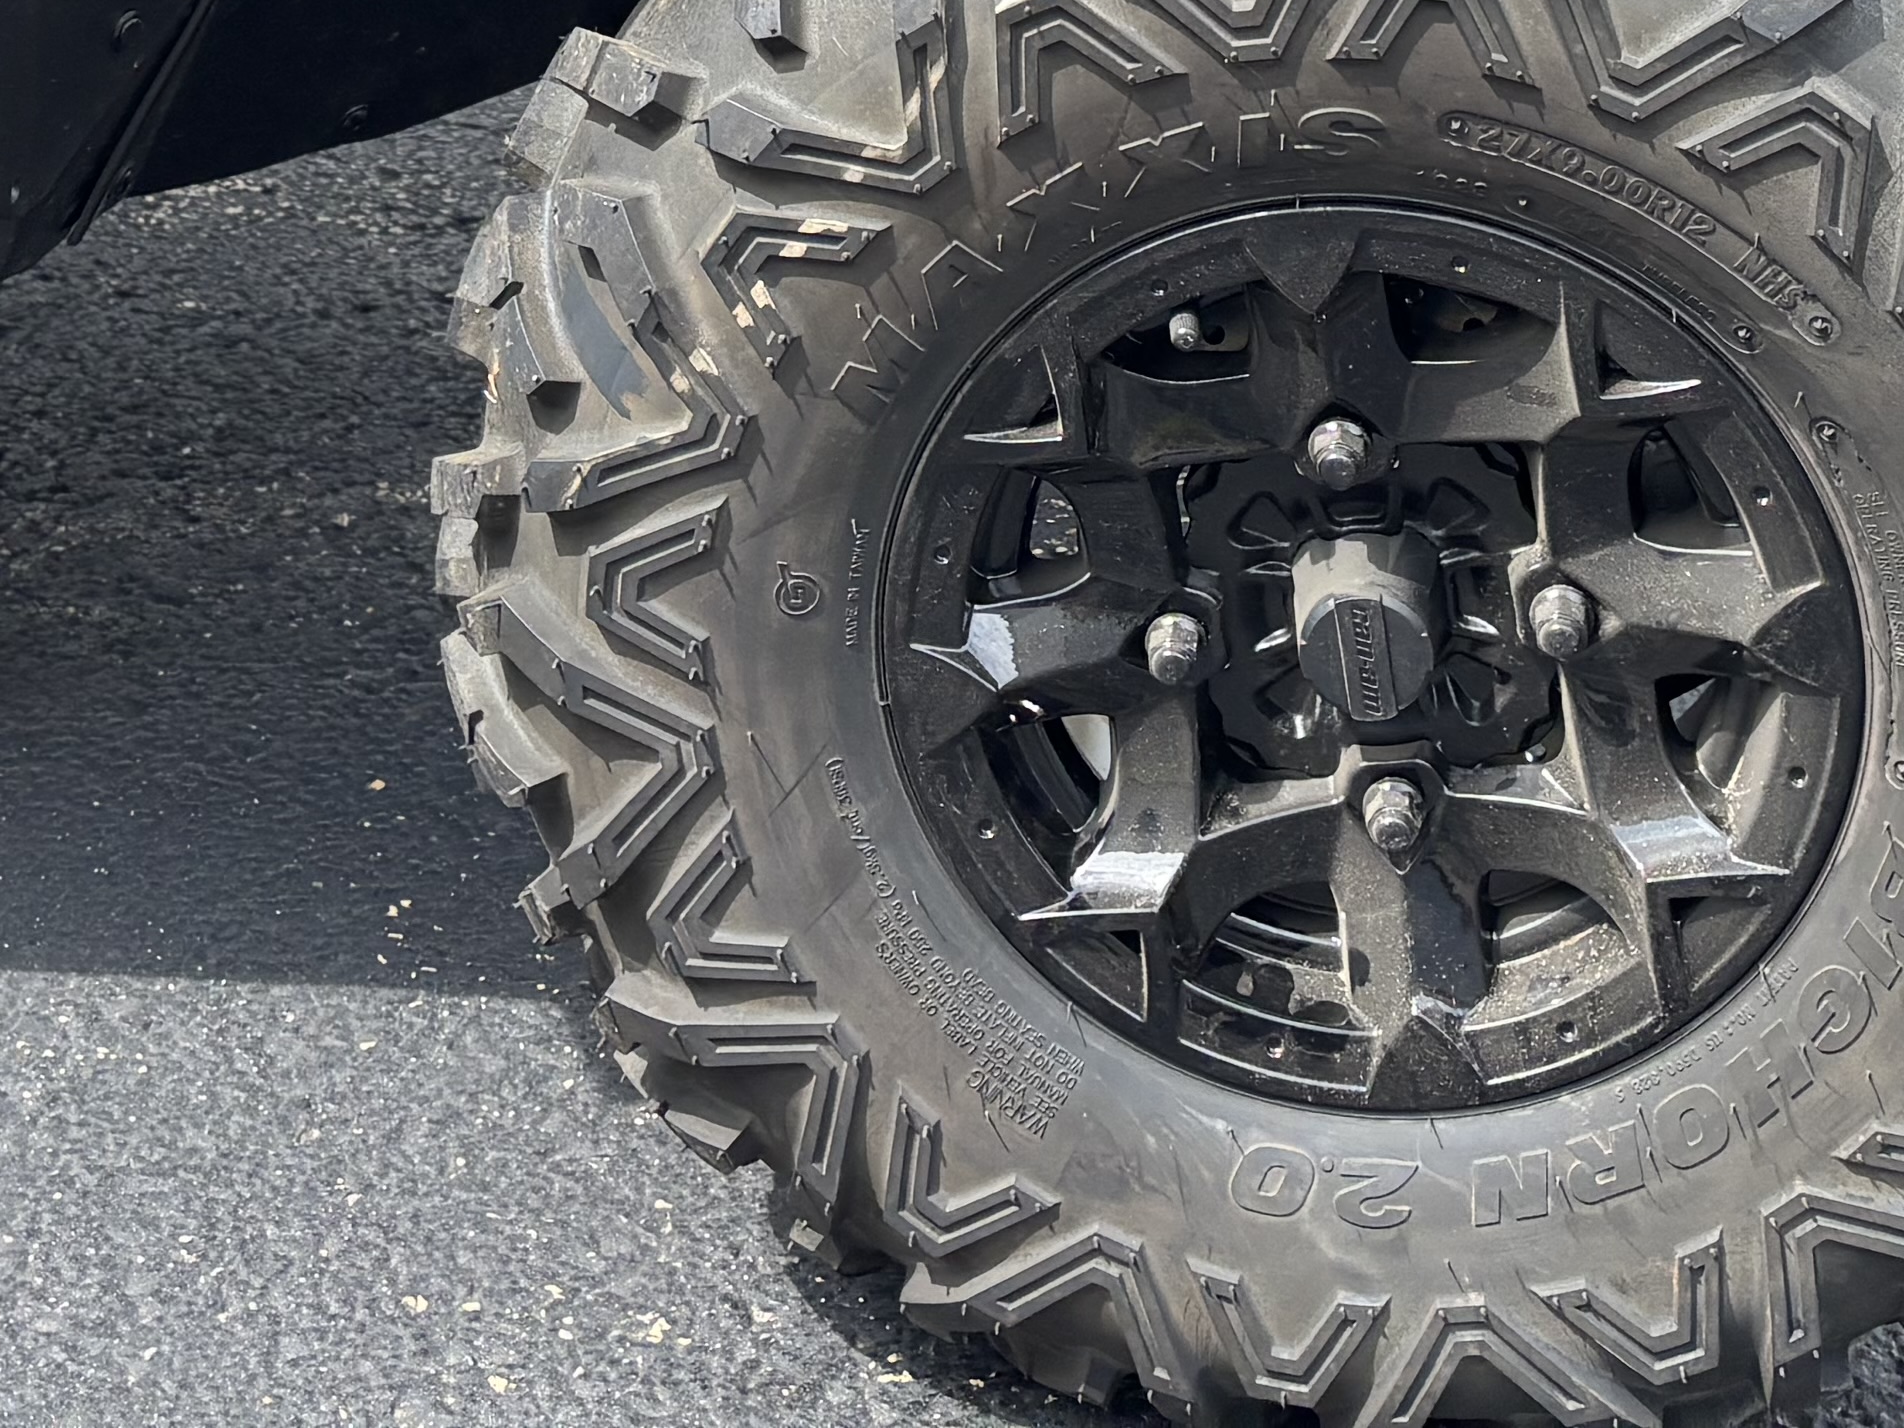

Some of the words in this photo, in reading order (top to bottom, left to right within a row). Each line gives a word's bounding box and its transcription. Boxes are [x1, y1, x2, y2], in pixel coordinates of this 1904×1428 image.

[826, 107, 1386, 418] MAXXIS
[1734, 244, 1808, 312] NHS
[874, 910, 928, 979] PRESSURE
[915, 993, 940, 1018] OR
[921, 975, 986, 1042] OPERATING
[990, 998, 1048, 1050] SEATING
[936, 1016, 978, 1056] LABEL
[982, 1037, 1015, 1066] FOR
[1044, 1040, 1088, 1076] WHEN
[975, 1052, 1029, 1098] VEHICLE
[1012, 1061, 1070, 1106] MANUAL
[1023, 1047, 1056, 1076] NOT
[1053, 1069, 1078, 1091] DO
[966, 1070, 1050, 1139] WARNING
[1028, 1093, 1060, 1119] SEE
[1230, 1144, 1418, 1228] 2.0
